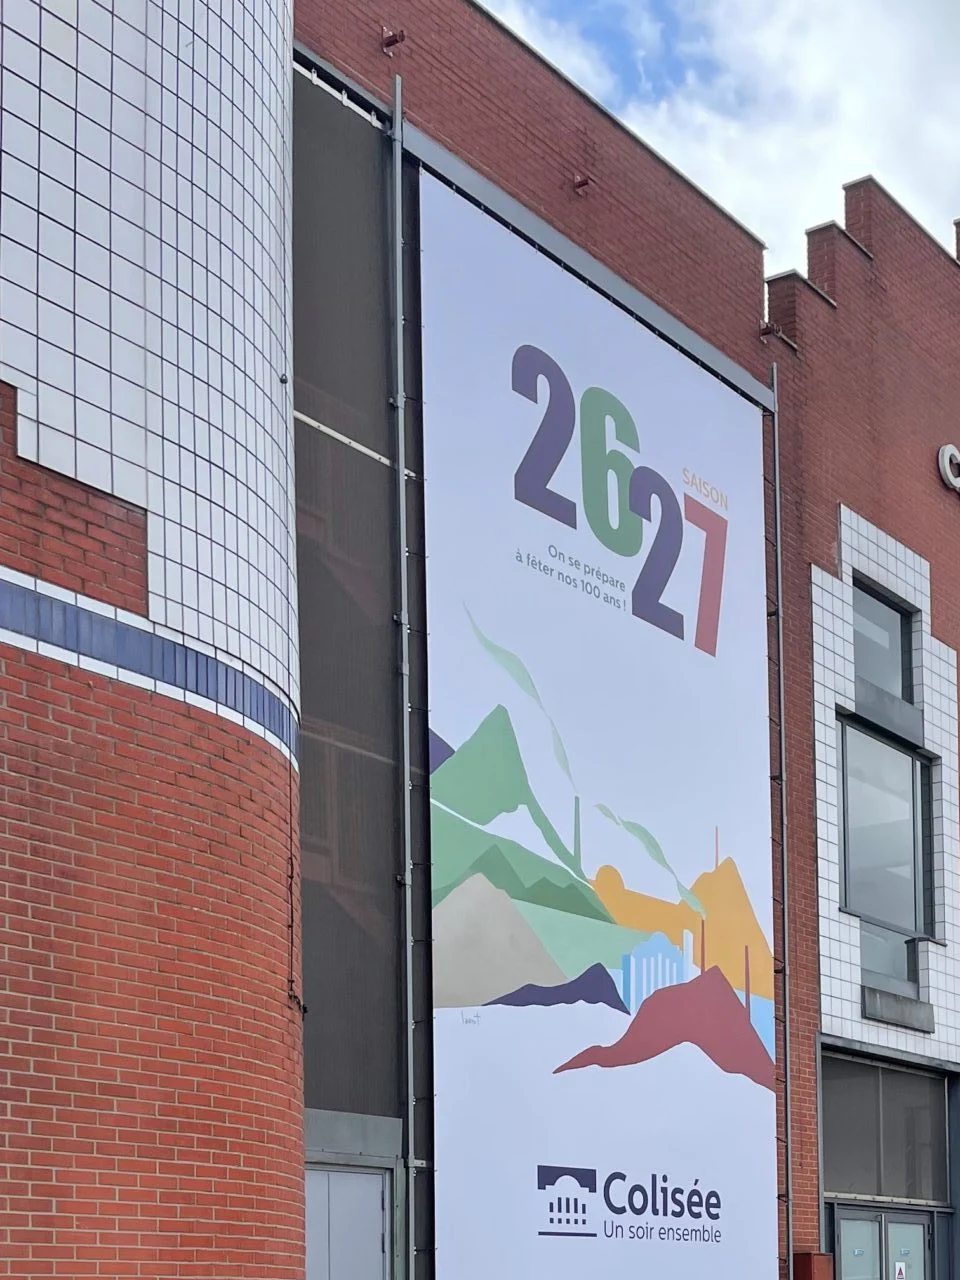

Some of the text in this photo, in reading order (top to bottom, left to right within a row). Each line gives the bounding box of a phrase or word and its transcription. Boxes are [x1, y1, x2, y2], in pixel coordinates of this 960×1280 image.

[682, 468, 728, 510] SAISON
[515, 548, 523, 563] à
[527, 553, 554, 577] fêter
[557, 570, 578, 589] nos
[580, 579, 601, 599] 100
[548, 545, 626, 592] On se prépare
[603, 1171, 721, 1221] Colisée
[603, 1220, 722, 1243] Un soir ensemble
